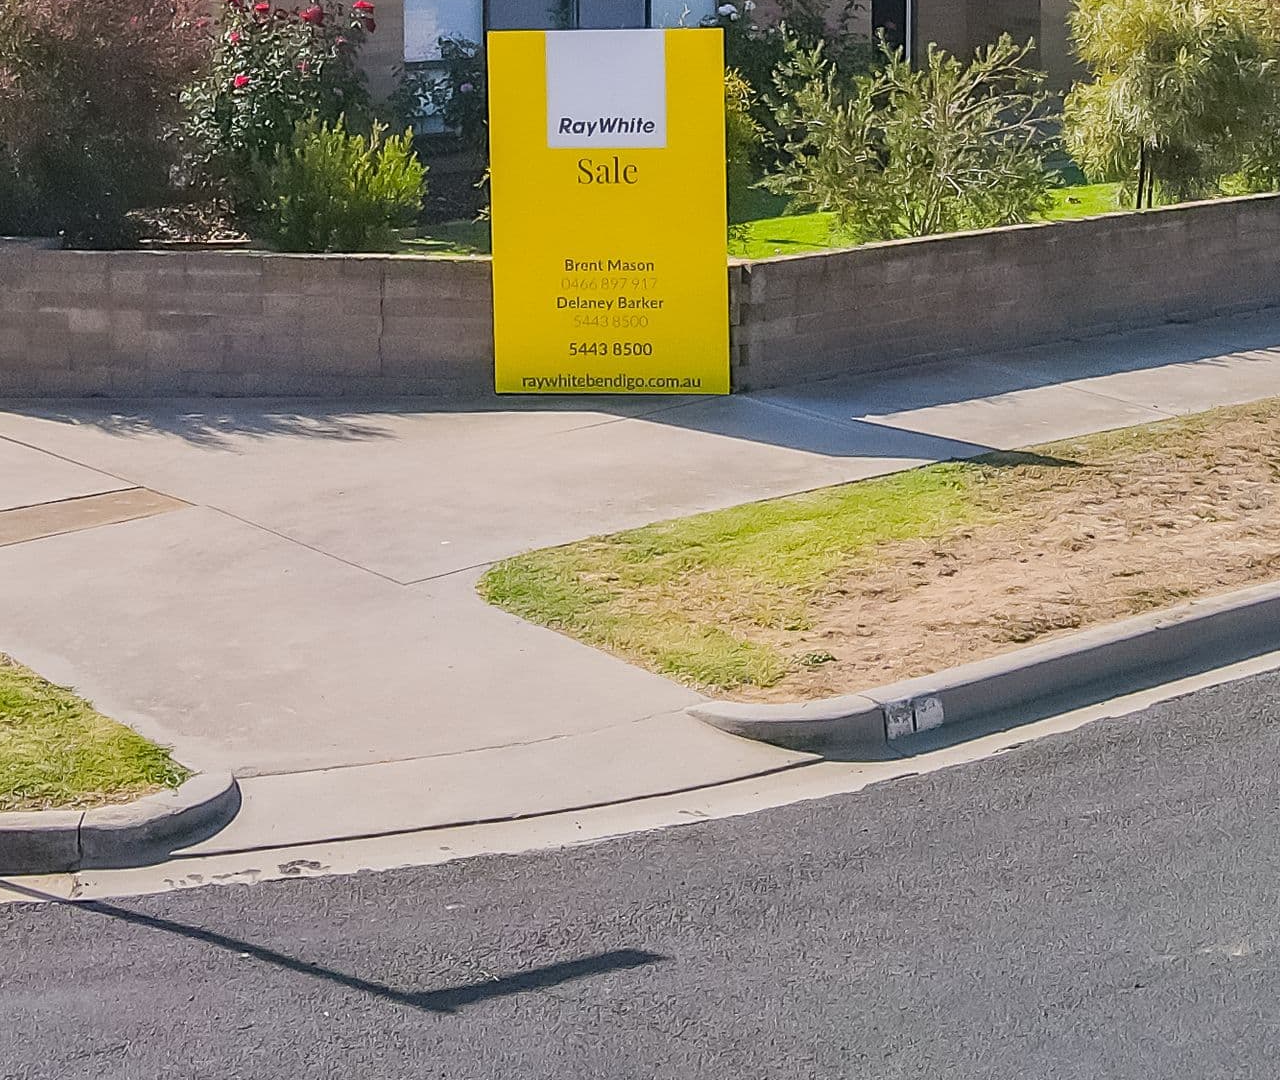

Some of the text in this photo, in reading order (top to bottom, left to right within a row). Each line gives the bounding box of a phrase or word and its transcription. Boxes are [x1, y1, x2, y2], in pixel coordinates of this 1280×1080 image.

[577, 156, 639, 185] Sale
[565, 258, 655, 272] Brent Mason
[556, 296, 664, 311] Delaney Barker
[574, 314, 649, 328] 5443 8500
[569, 341, 653, 356] 5443 8500
[522, 373, 701, 391] raywhitebendigo.com.au
